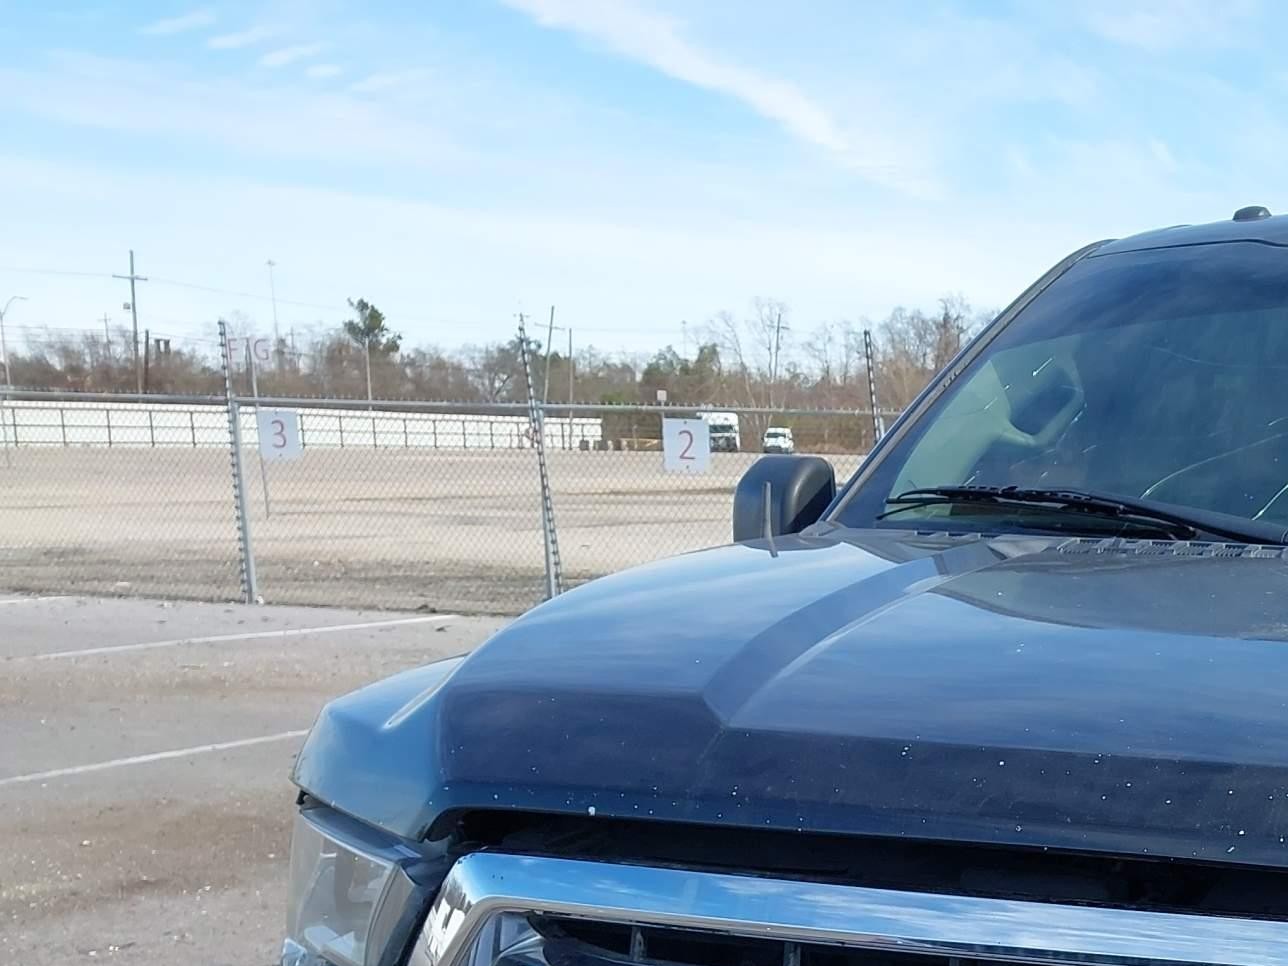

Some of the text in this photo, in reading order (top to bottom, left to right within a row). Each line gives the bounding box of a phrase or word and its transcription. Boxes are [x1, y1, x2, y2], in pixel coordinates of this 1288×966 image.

[227, 338, 238, 361] F
[253, 338, 269, 361] G
[271, 419, 287, 448] 3
[678, 430, 696, 460] 2
